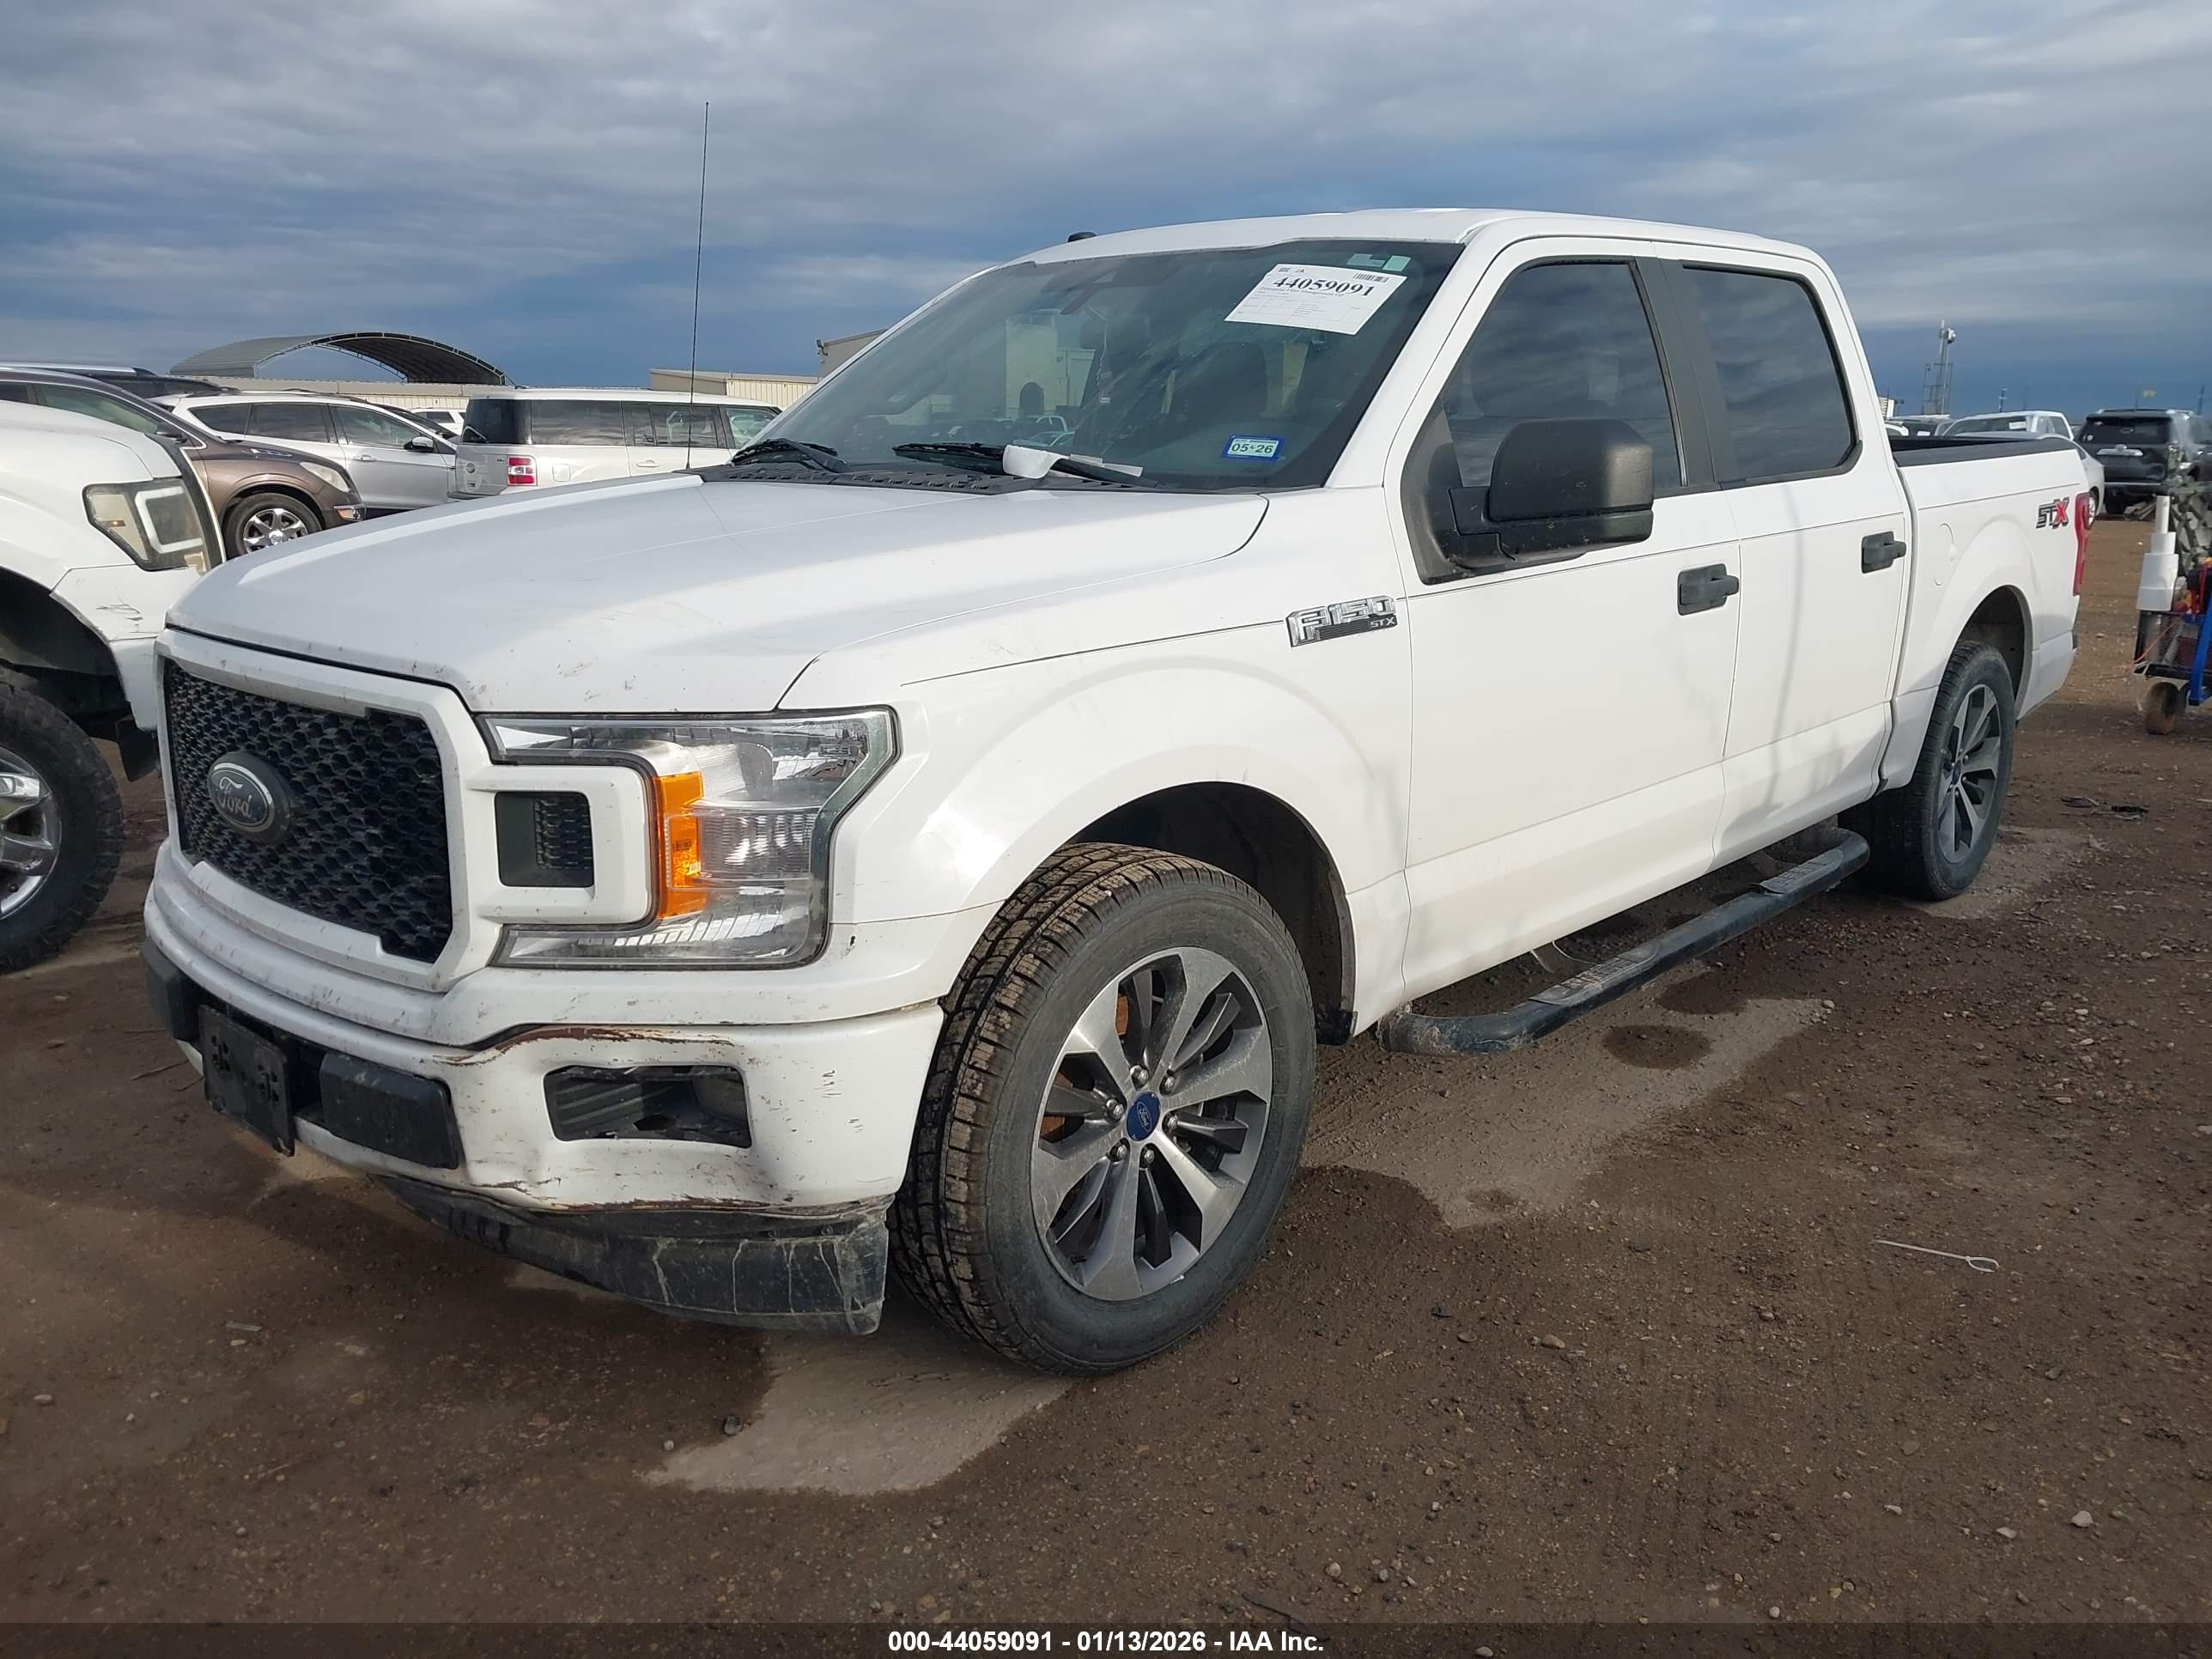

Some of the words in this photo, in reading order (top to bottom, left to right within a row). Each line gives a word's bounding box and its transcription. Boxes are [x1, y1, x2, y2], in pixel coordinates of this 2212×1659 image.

[1273, 276, 1375, 297] 44059091
[2036, 496, 2069, 530] STX
[1370, 617, 1395, 629] STX
[217, 775, 253, 818] Ford
